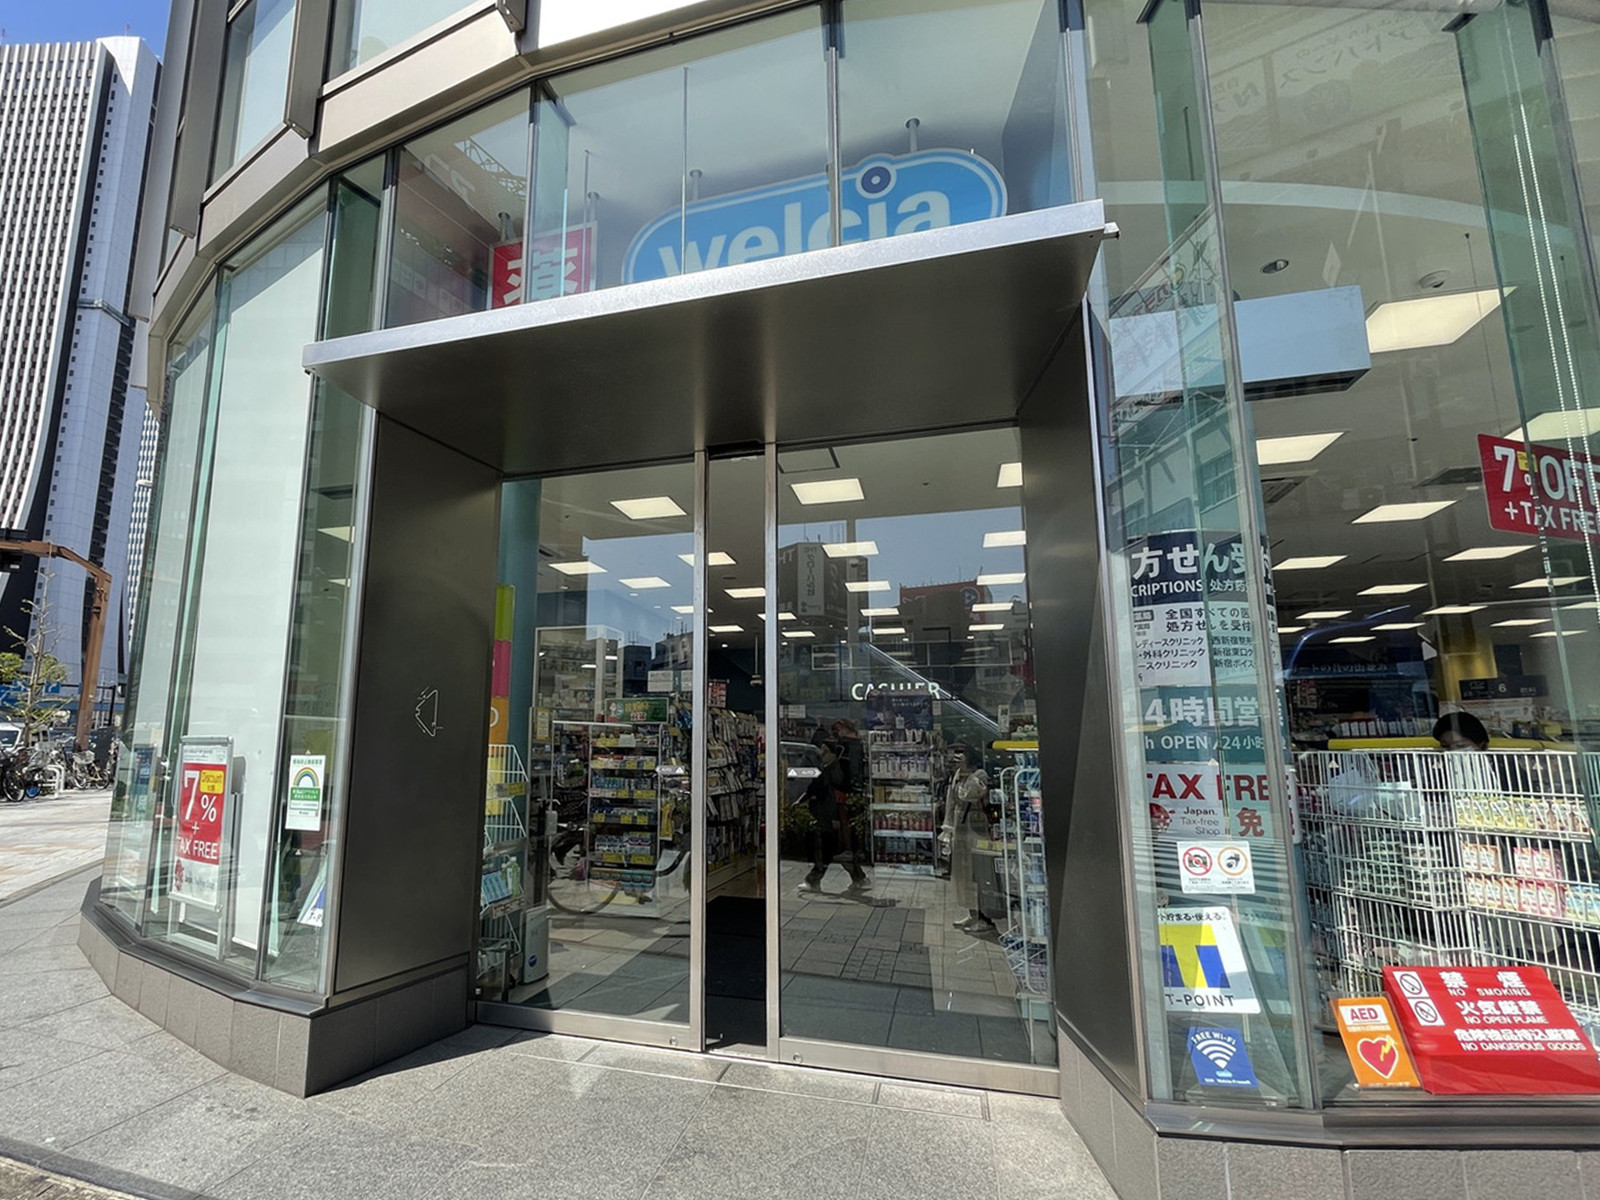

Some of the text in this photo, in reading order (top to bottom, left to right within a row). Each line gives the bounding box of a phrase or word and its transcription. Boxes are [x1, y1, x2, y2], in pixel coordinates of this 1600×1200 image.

[659, 165, 951, 277] welcia
[1161, 735, 1208, 750] OPEN
[1146, 773, 1206, 800] AX
[1181, 816, 1219, 826] Tax-free
[1195, 826, 1220, 837] Shop
[193, 839, 218, 860] FREE
[1448, 988, 1531, 996] NO SMOKING
[1164, 993, 1235, 1007] T-POINT
[1350, 1007, 1378, 1021] AED
[1464, 1016, 1481, 1024] NO
[1483, 1016, 1512, 1024] OPEN
[1460, 1043, 1586, 1051] NO DANGEROUS GOODS
